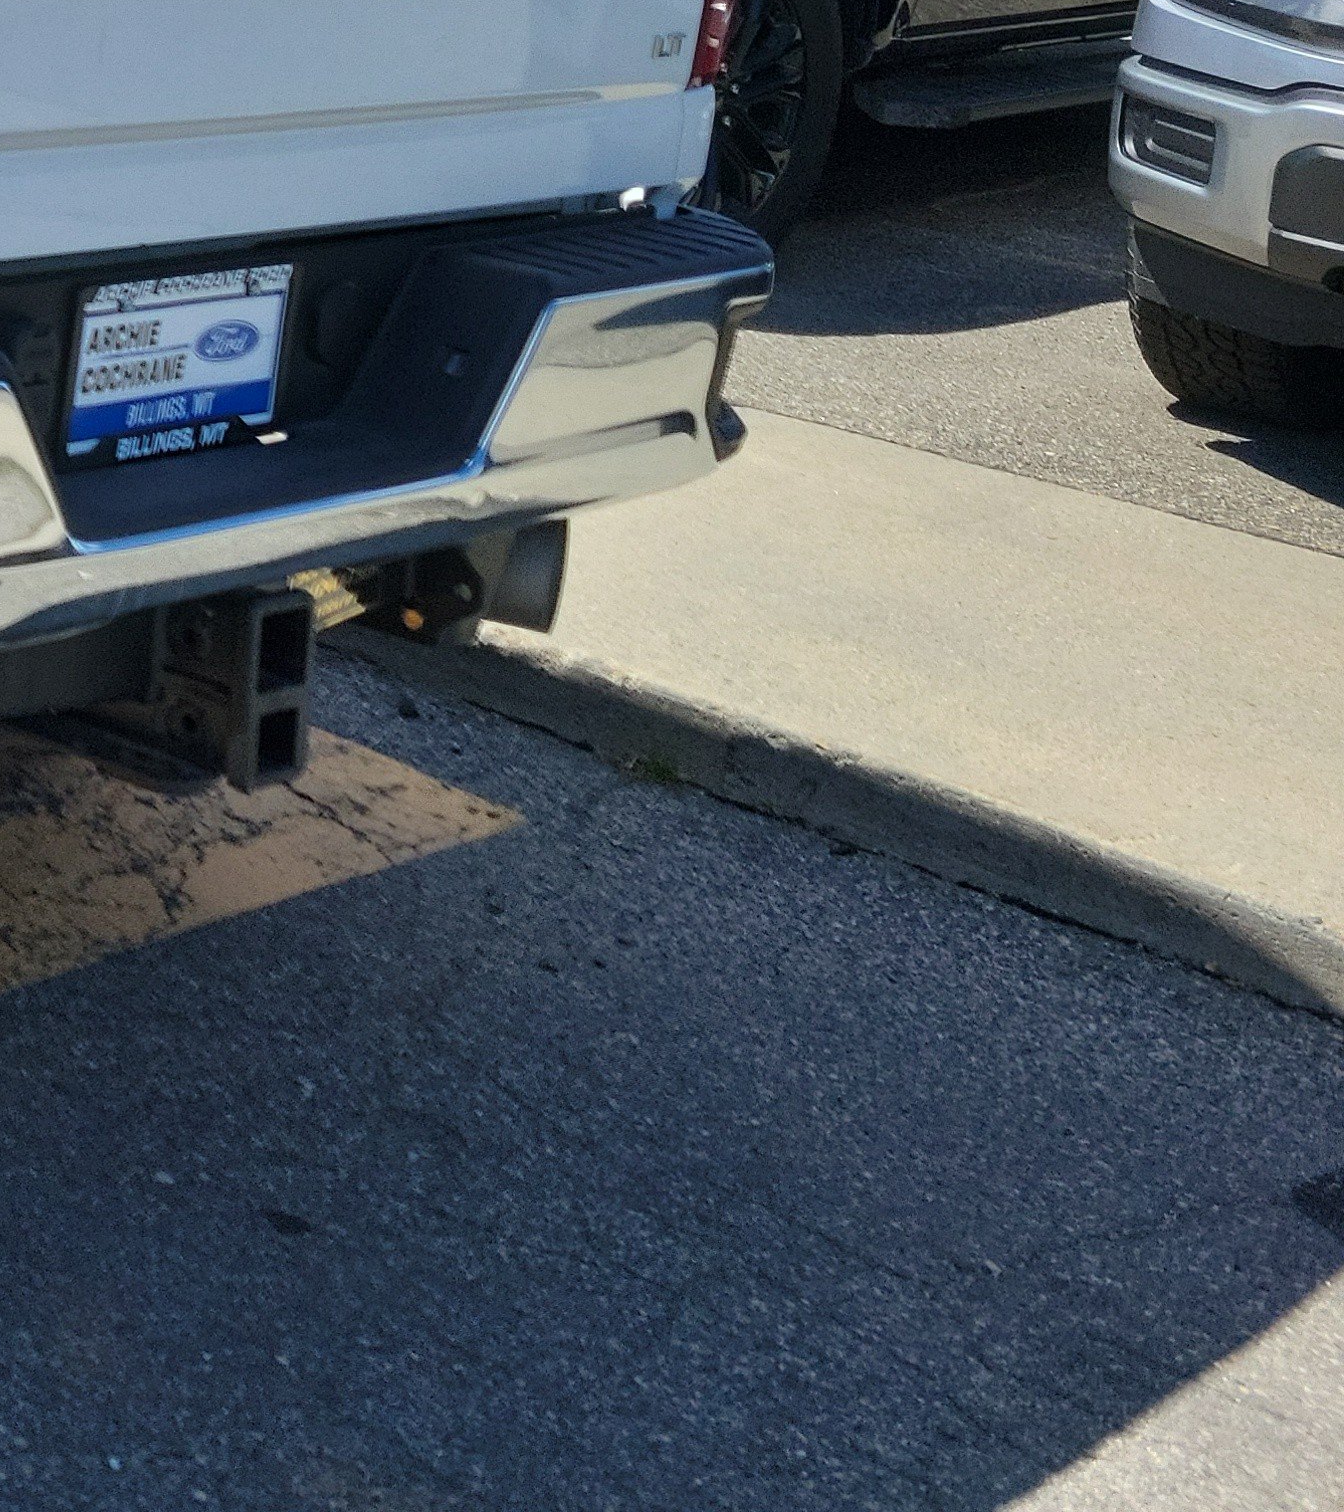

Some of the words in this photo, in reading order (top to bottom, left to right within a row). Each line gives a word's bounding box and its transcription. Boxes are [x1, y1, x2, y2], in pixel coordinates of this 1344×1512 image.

[652, 33, 686, 58] LT
[87, 319, 161, 355] ARCHIE
[205, 325, 249, 357] Ford
[81, 353, 188, 394] COCHRANE
[124, 395, 188, 428] BILLINGS,
[192, 391, 217, 417] MT
[116, 427, 196, 462] BILLINGS,
[199, 421, 231, 446] MT
